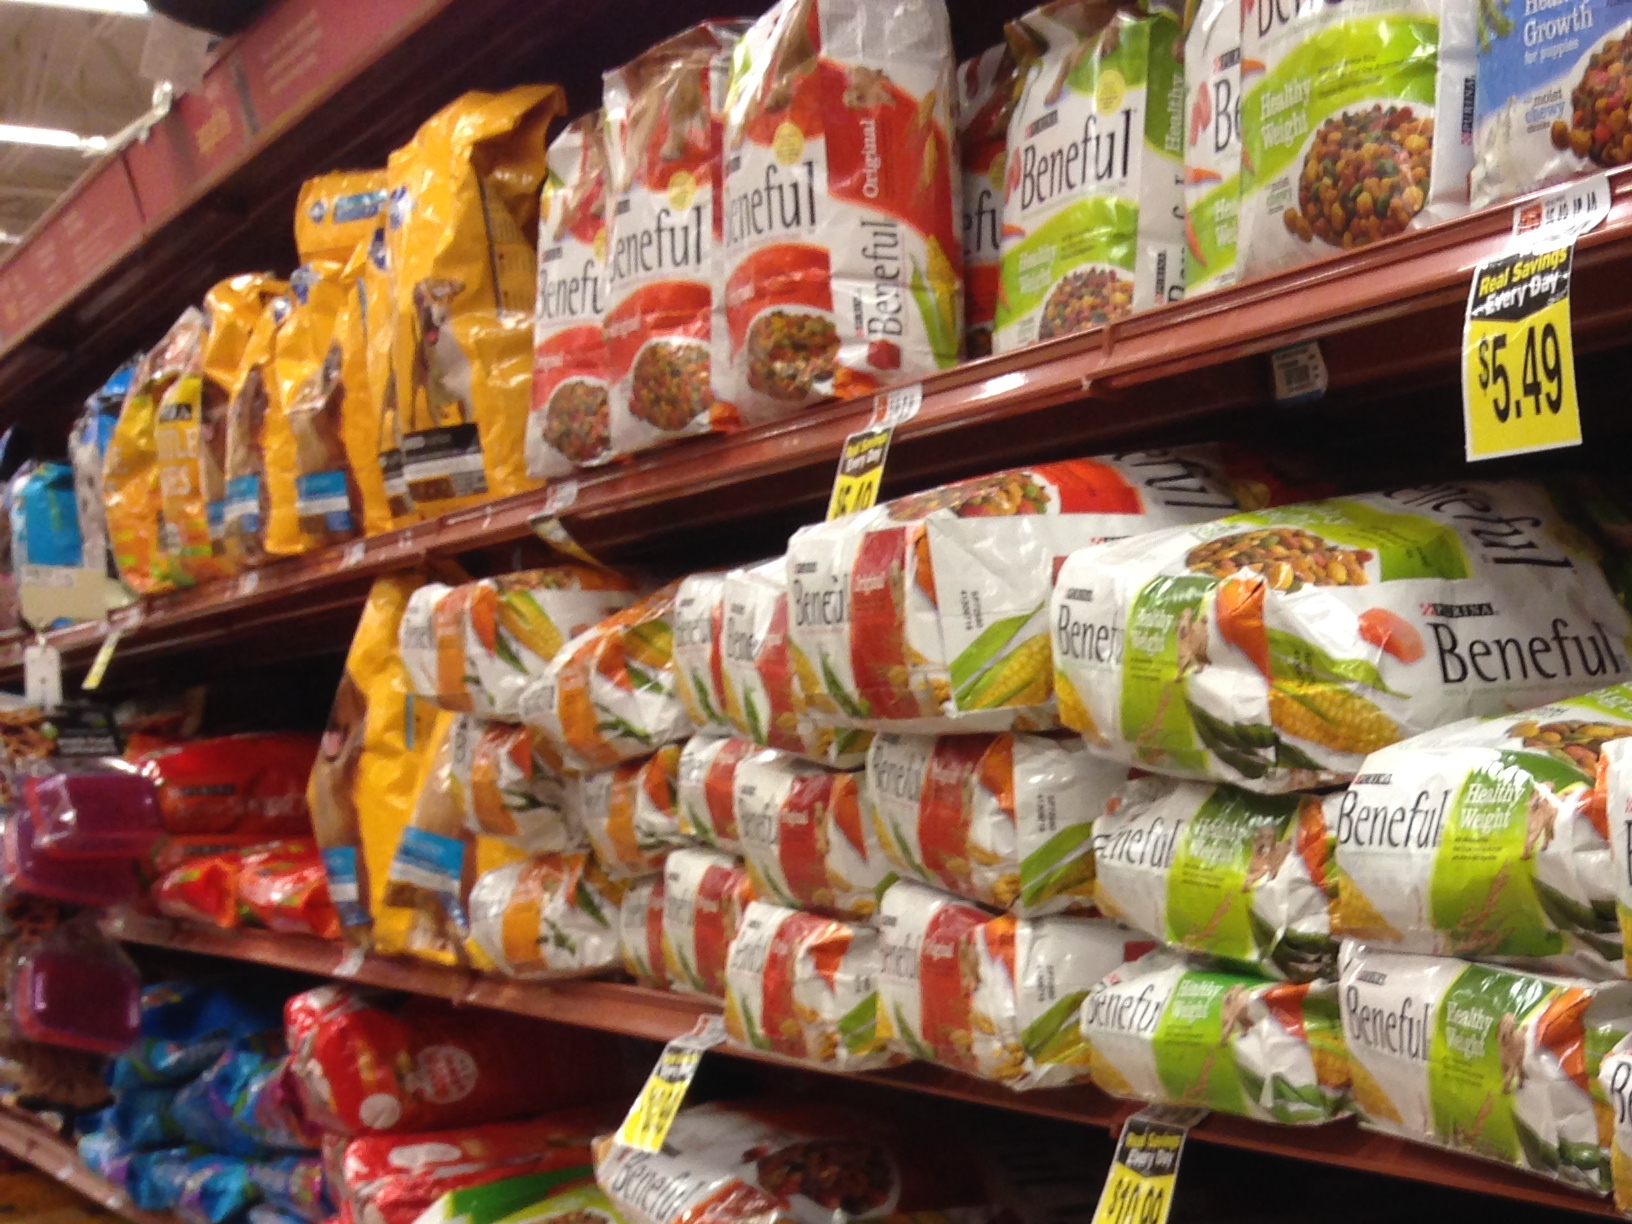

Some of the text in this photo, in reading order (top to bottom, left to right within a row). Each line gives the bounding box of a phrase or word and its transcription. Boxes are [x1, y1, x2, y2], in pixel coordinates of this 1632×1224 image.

[1524, 5, 1593, 47] Growth
[1260, 77, 1311, 117] Healthy
[863, 119, 880, 199] Original
[1263, 111, 1309, 151] Weight
[1020, 110, 1134, 210] Beneful
[725, 161, 817, 248] eneful
[609, 205, 702, 283] eneful
[1479, 245, 1568, 297] Real Savings
[861, 216, 902, 338] Beneful
[1486, 272, 1558, 314] Every Day
[1479, 322, 1563, 423] $5.49
[1428, 617, 1620, 684] Beneful
[1336, 787, 1449, 849] Beneful
[1459, 808, 1511, 831] Weight
[1467, 781, 1526, 811] Healthy
[1093, 816, 1184, 869] neful
[1345, 985, 1431, 1062] Beneful
[1447, 1000, 1493, 1037] Healthy
